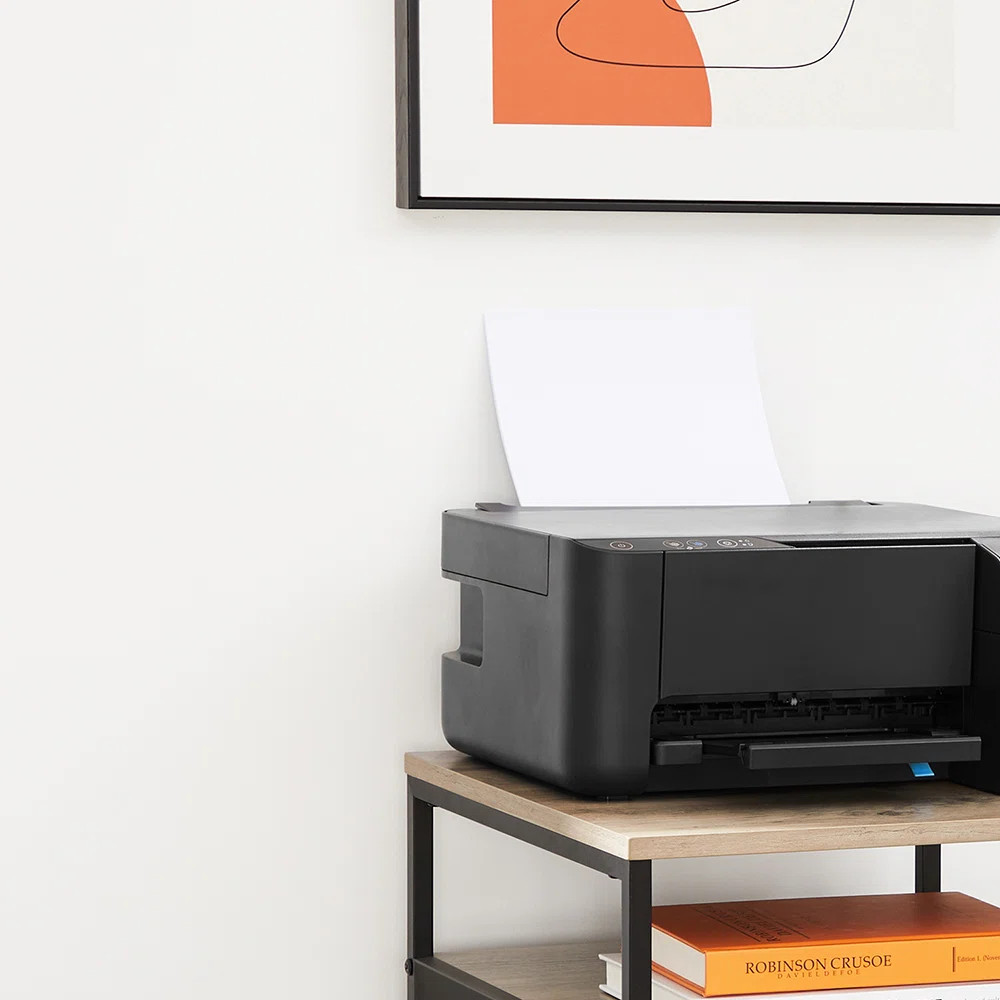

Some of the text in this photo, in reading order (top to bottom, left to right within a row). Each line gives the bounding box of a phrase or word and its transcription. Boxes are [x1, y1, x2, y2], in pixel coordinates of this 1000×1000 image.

[745, 954, 892, 974] ROBINSON CRUSOE
[824, 969, 862, 977] DEFOE
